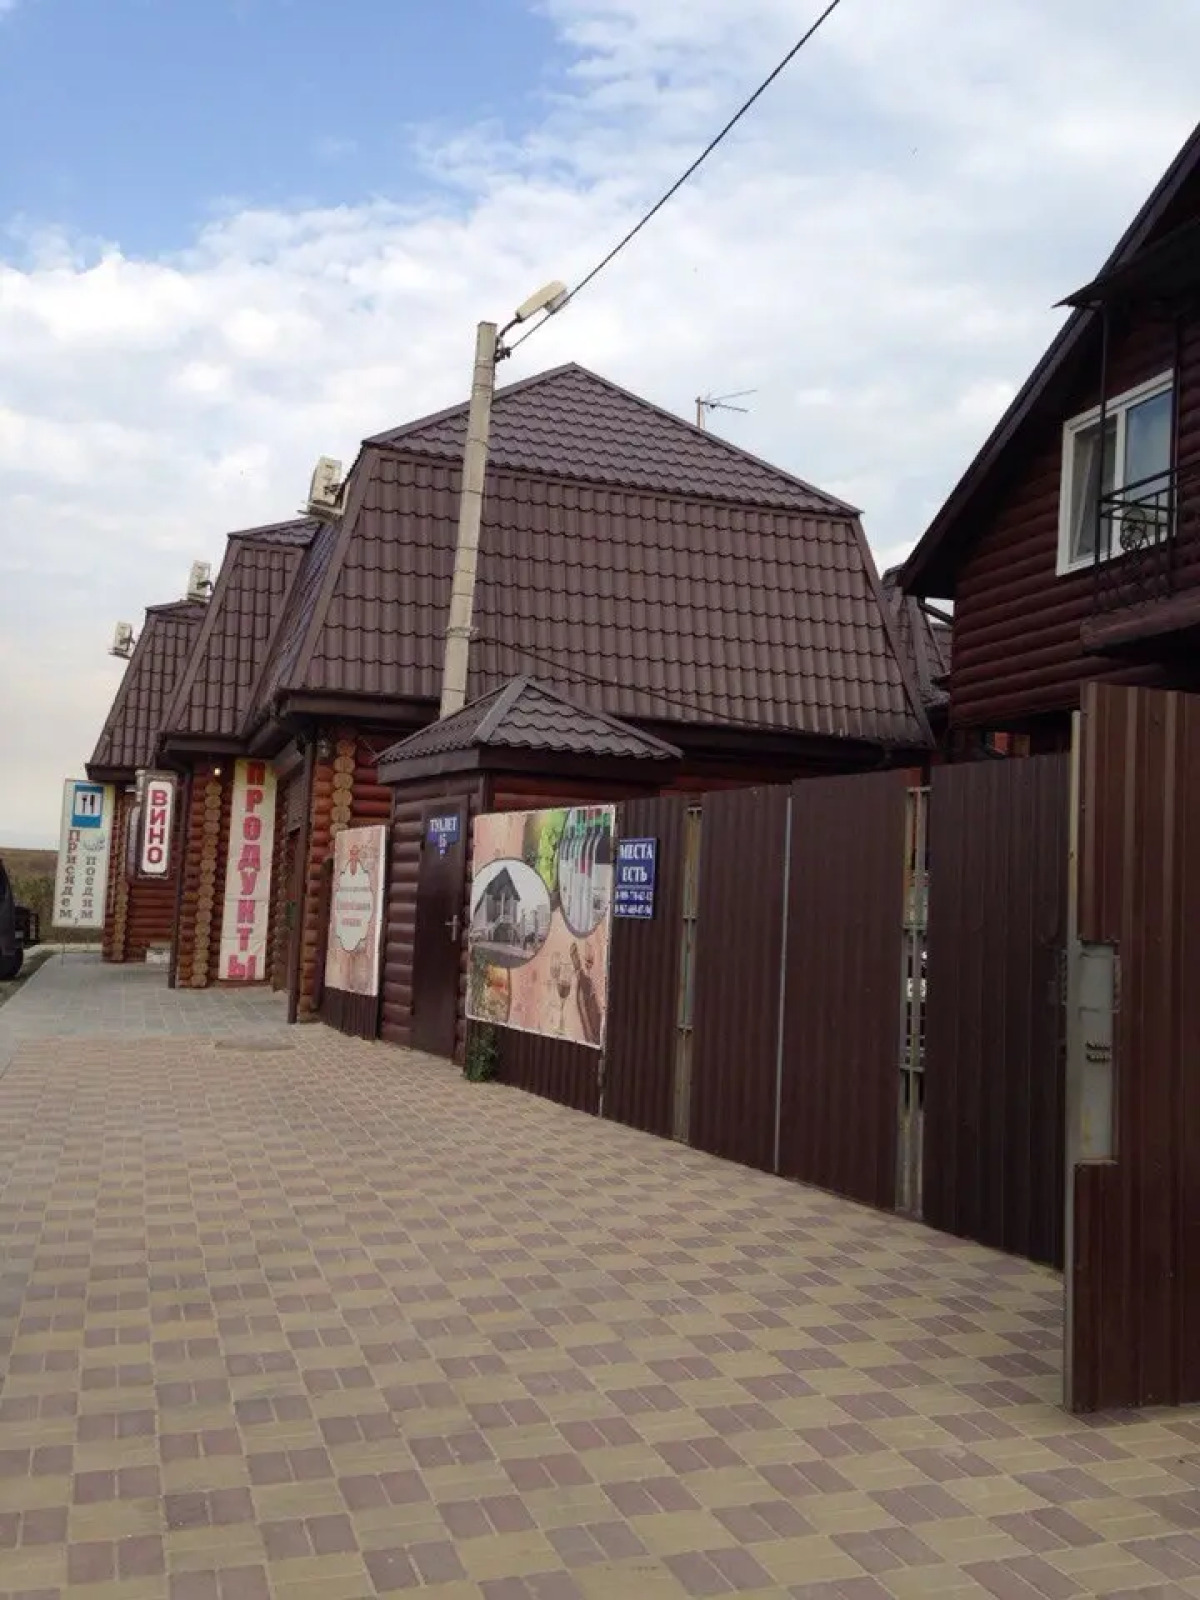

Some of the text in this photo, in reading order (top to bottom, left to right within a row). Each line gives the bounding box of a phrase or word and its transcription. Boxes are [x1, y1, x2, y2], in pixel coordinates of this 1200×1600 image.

[147, 790, 168, 864] ВИНО
[227, 761, 265, 979] ПРОДУКТЫ
[619, 844, 653, 859] МЕСТА
[622, 866, 648, 883] ЕСТЬ
